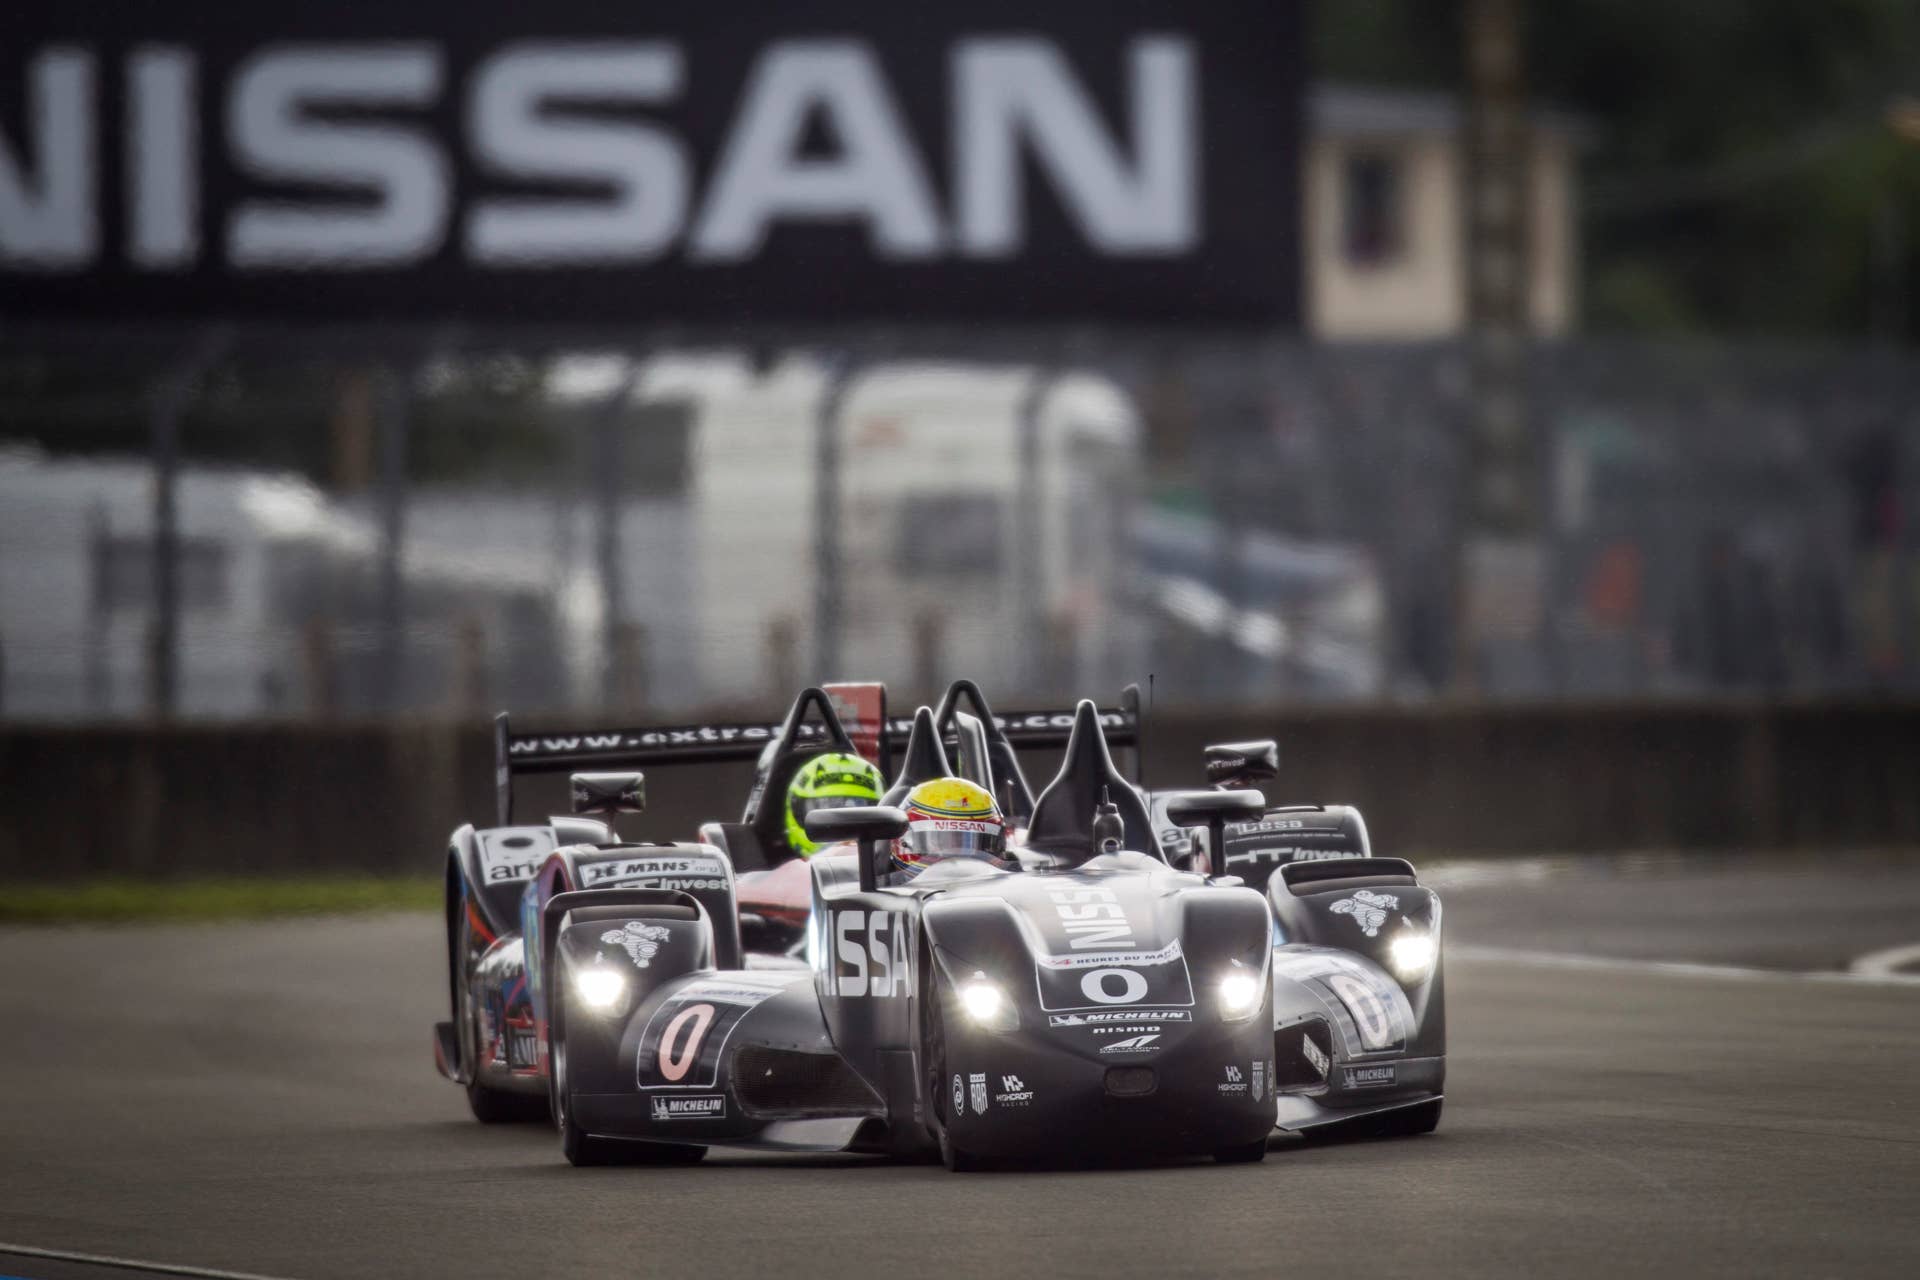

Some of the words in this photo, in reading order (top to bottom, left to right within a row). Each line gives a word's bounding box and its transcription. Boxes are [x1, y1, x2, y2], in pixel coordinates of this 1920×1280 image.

[934, 821, 986, 832] NISSAN
[625, 862, 690, 874] MANS
[660, 878, 729, 890] Invest
[1076, 956, 1120, 964] HEURES
[1081, 968, 1148, 1004] 0
[1086, 1012, 1184, 1022] MICHELIN
[659, 1003, 715, 1081] 0
[1356, 1067, 1394, 1081] MICHELIN
[996, 1091, 1033, 1102] HIGHCROFT
[669, 1099, 722, 1112] MICHELIN
